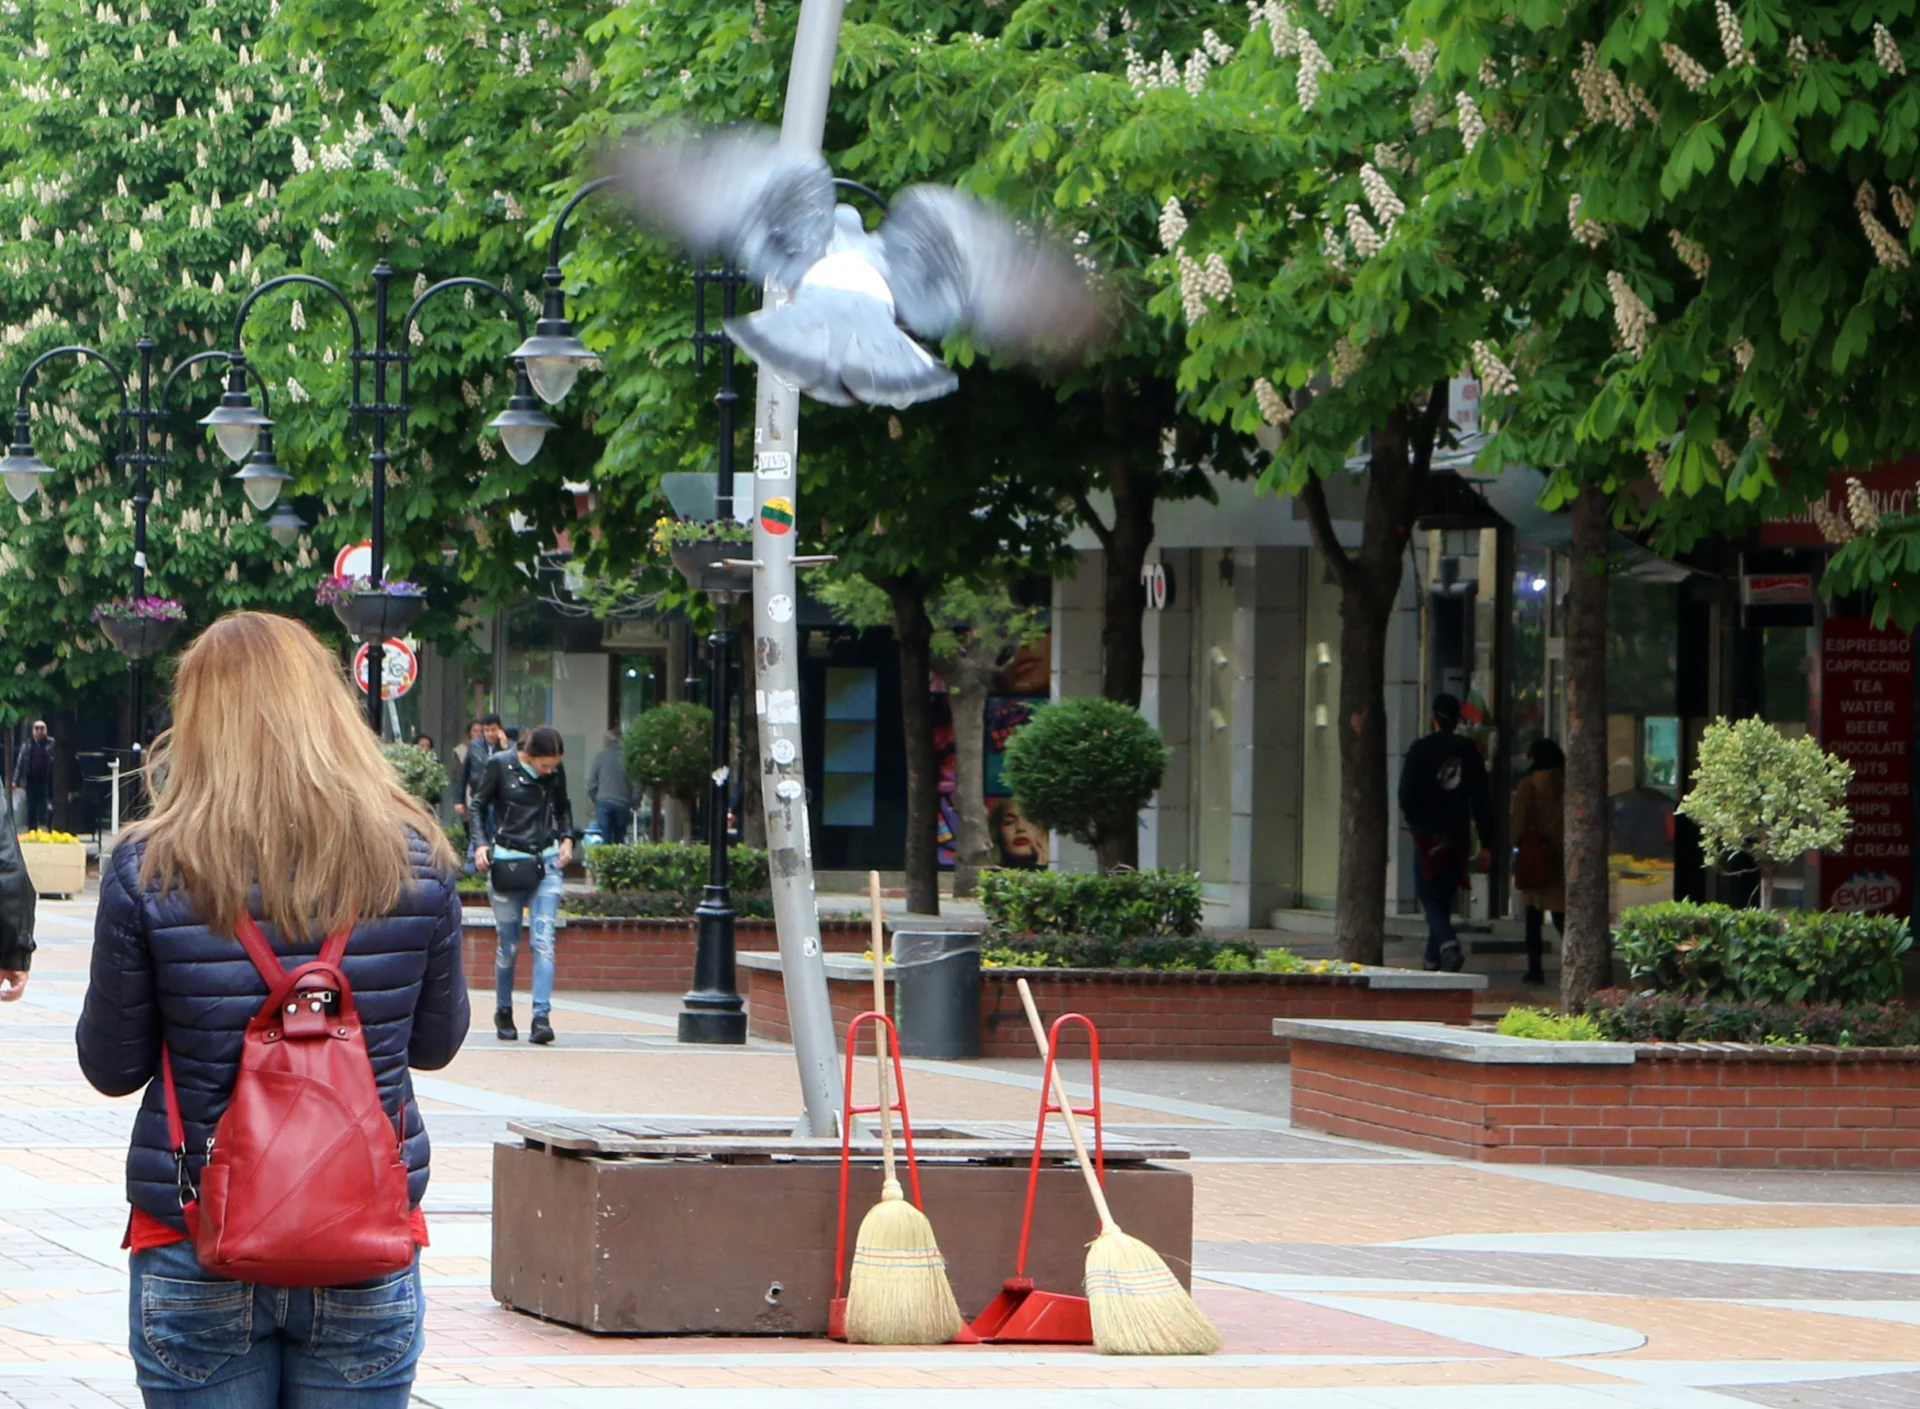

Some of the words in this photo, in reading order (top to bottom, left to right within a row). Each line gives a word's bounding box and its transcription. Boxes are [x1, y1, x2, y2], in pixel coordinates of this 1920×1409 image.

[1826, 638, 1911, 653] ESPRESSO
[1826, 659, 1911, 673] CAPPUCCINO
[1852, 679, 1884, 694] TEA
[1840, 700, 1896, 714] WATER
[1845, 720, 1889, 735] BEER
[1829, 740, 1907, 755] CHOCOLATE
[1852, 822, 1903, 837] OKIES
[1853, 842, 1910, 857] CREAM
[1836, 883, 1897, 906] evian
